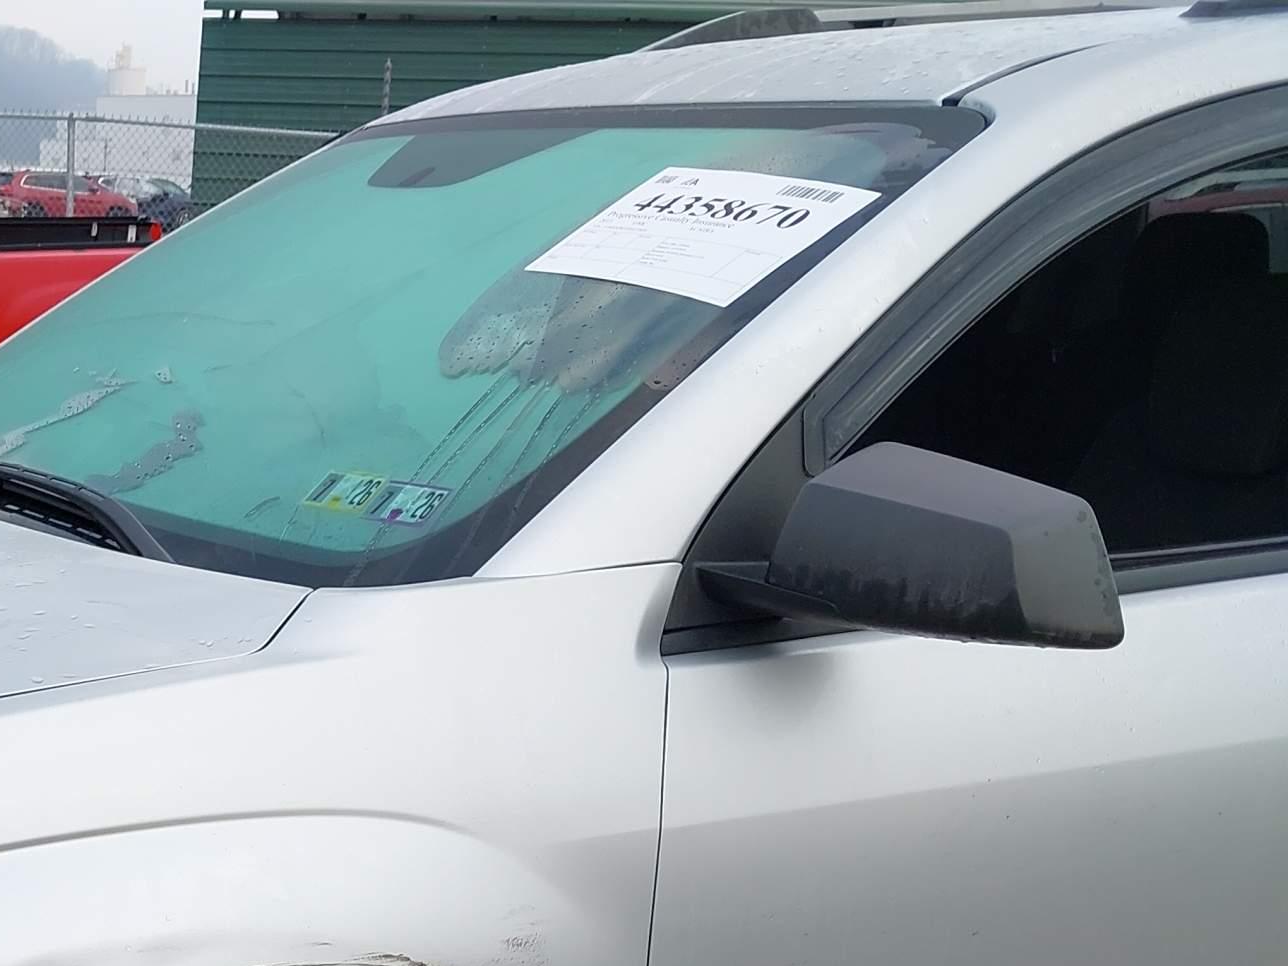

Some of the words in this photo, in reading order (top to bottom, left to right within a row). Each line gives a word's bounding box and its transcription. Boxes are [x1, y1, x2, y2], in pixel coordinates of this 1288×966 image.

[634, 192, 811, 230] 44358670
[347, 479, 383, 506] 26
[409, 491, 445, 519] 26
